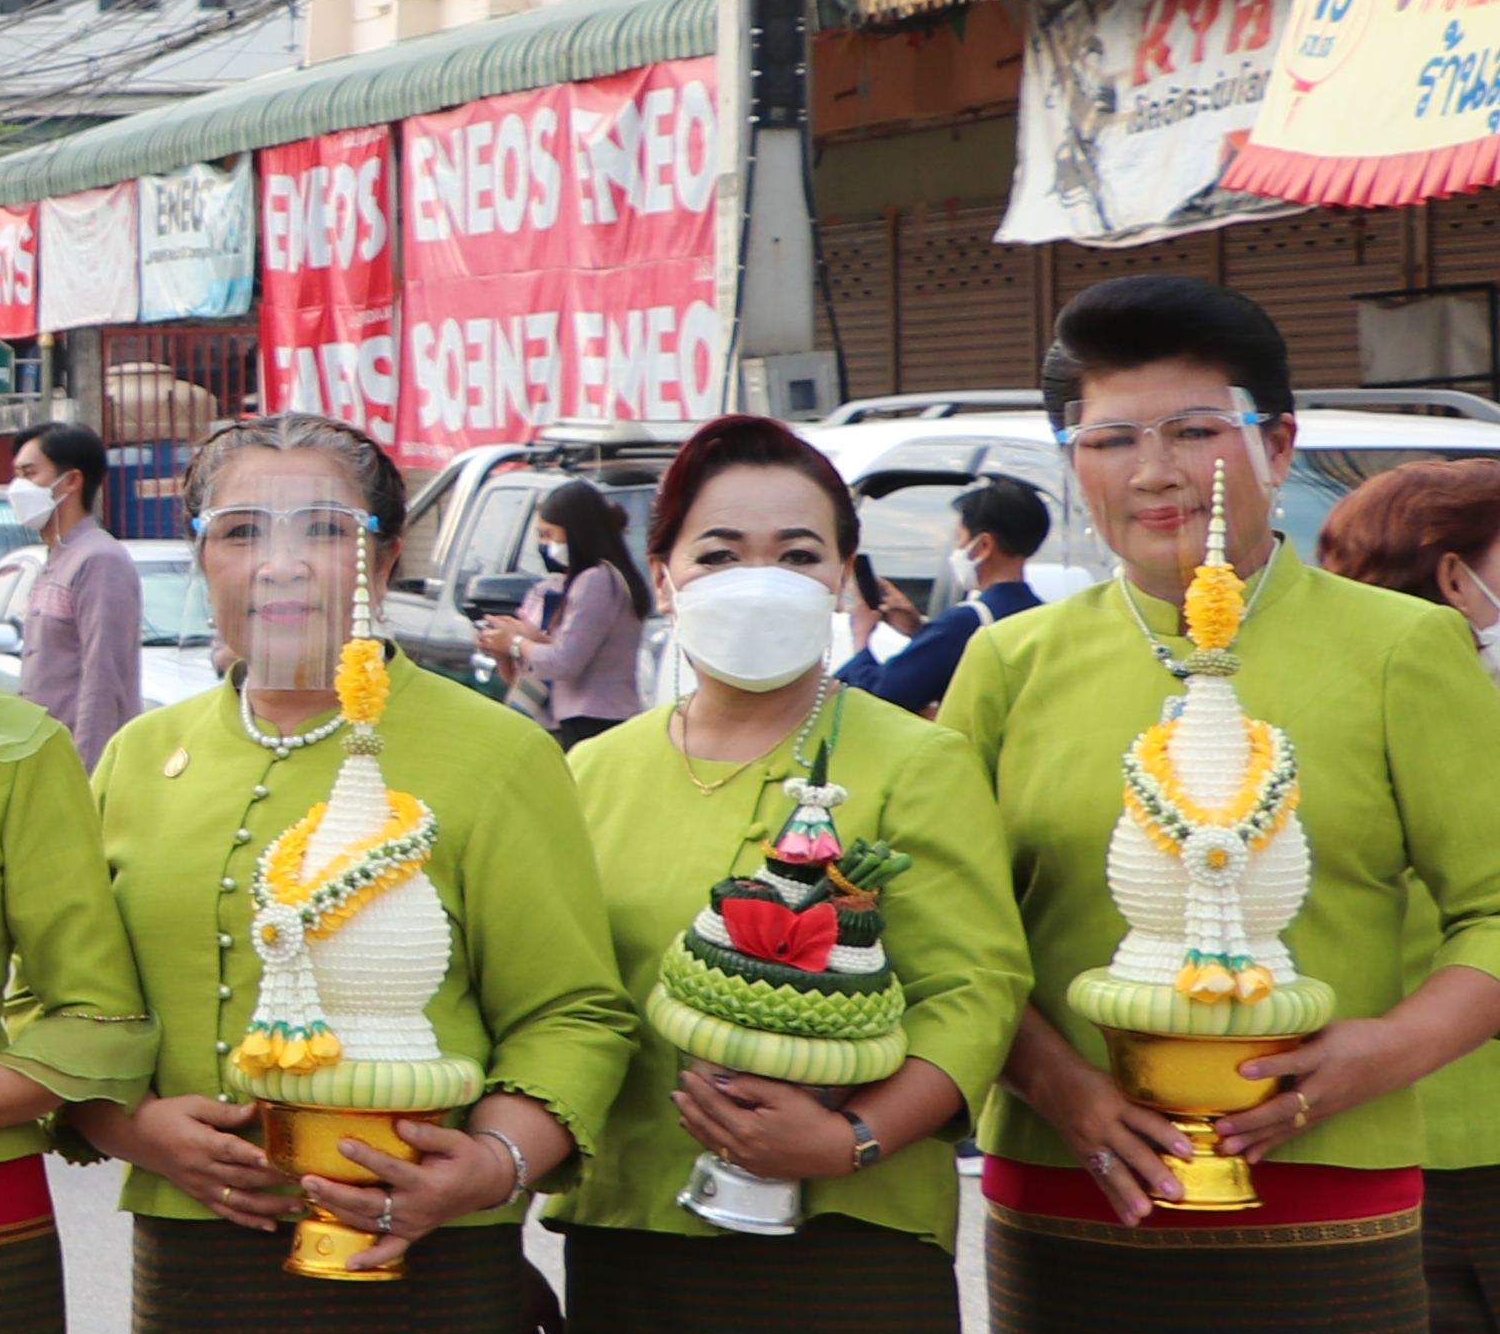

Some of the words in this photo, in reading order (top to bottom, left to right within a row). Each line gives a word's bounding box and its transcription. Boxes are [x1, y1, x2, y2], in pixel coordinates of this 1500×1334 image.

[265, 156, 387, 273] ENEOS
[410, 106, 562, 243] ENEOS
[570, 79, 719, 226] ENEO
[572, 299, 724, 424] ENEO
